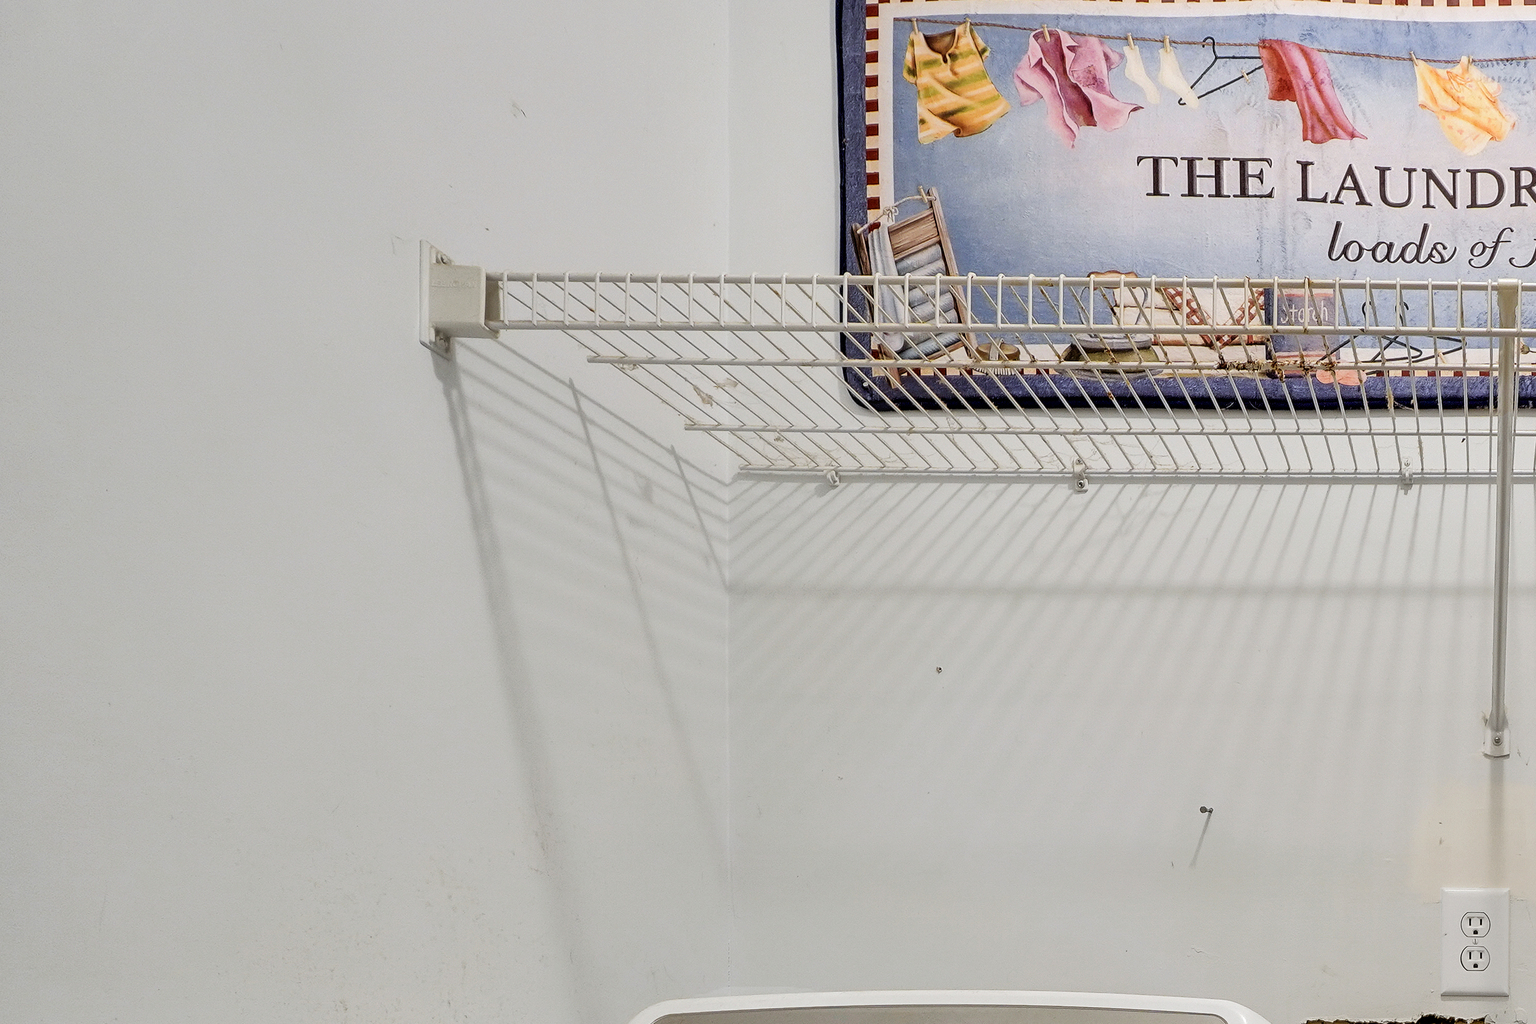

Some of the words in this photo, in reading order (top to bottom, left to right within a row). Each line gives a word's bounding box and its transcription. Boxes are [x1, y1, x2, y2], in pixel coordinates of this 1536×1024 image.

[1136, 155, 1276, 200] THE
[1327, 220, 1457, 265] loads
[1467, 226, 1515, 269] of
